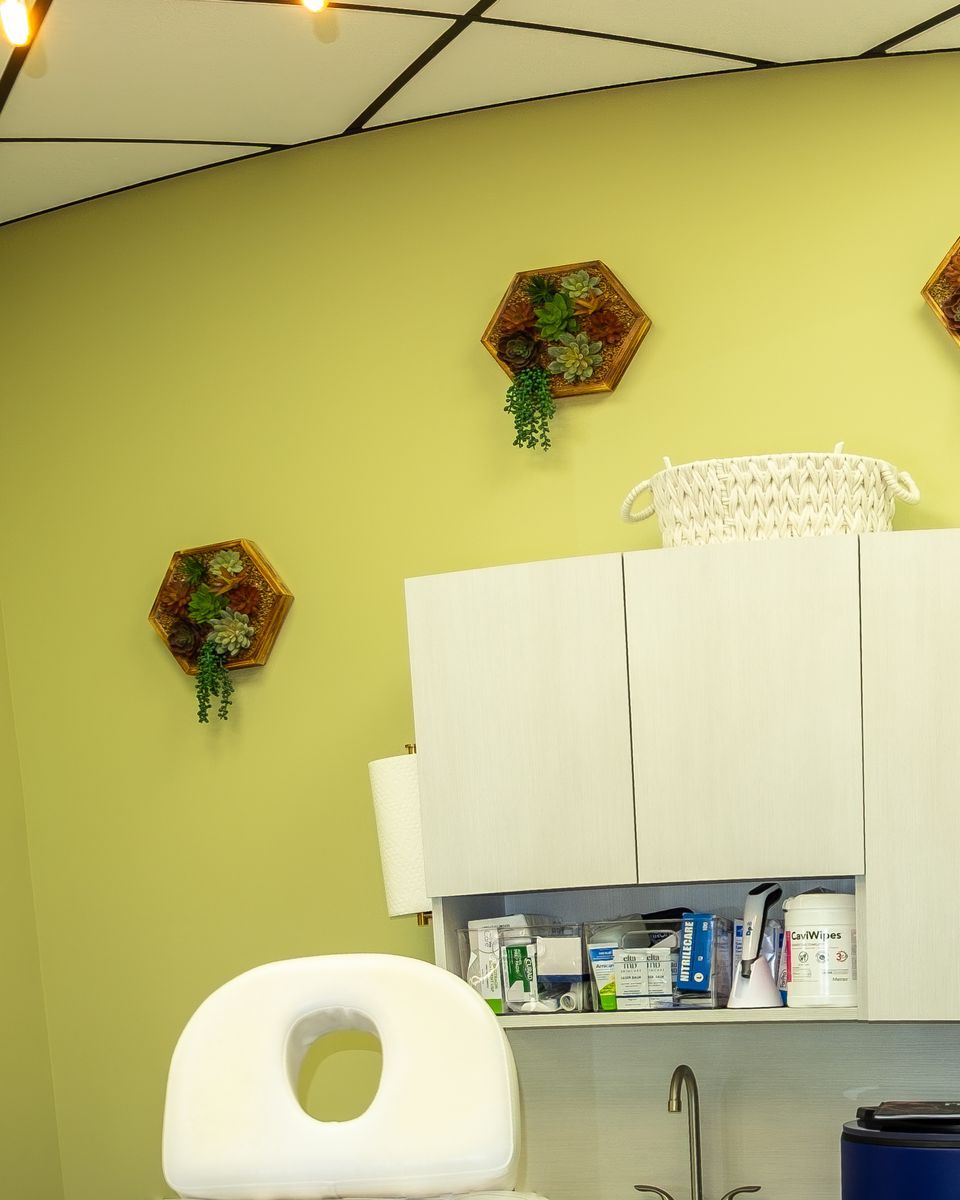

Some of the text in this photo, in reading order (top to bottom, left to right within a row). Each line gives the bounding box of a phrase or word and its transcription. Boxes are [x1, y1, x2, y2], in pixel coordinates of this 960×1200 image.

[791, 930, 842, 942] CaviWipes
[680, 919, 694, 982] NITRILECARE
[525, 958, 533, 980] CURAD
